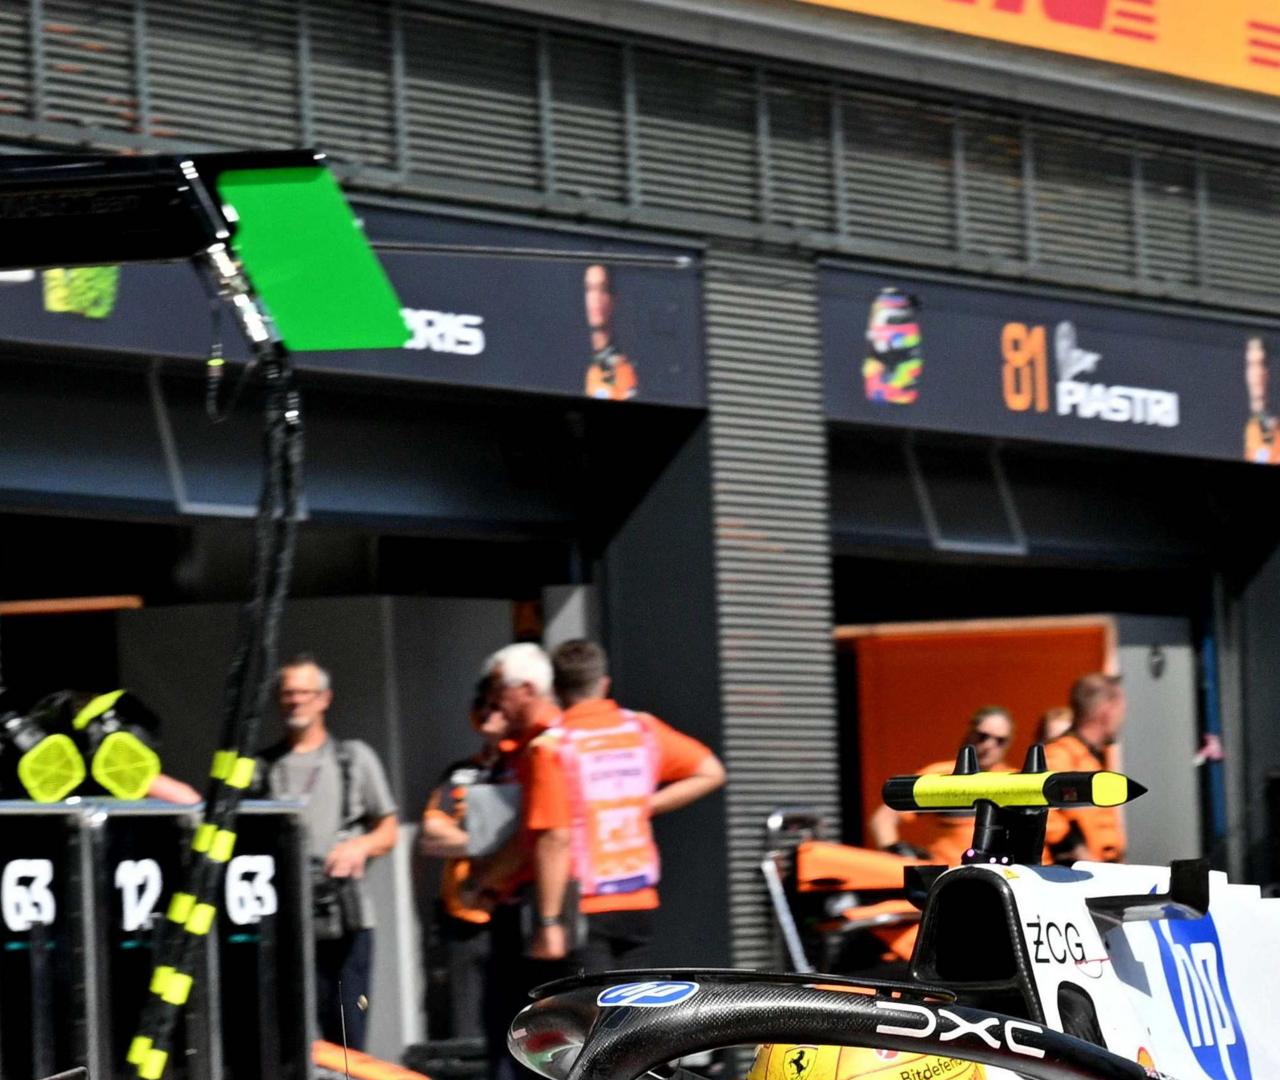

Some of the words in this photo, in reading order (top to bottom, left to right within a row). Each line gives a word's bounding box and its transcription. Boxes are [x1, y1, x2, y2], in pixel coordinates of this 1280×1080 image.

[1001, 321, 1049, 413] 81
[1056, 379, 1180, 428] PIASTRI
[599, 981, 698, 1006] hp
[875, 1000, 1046, 1059] DXC
